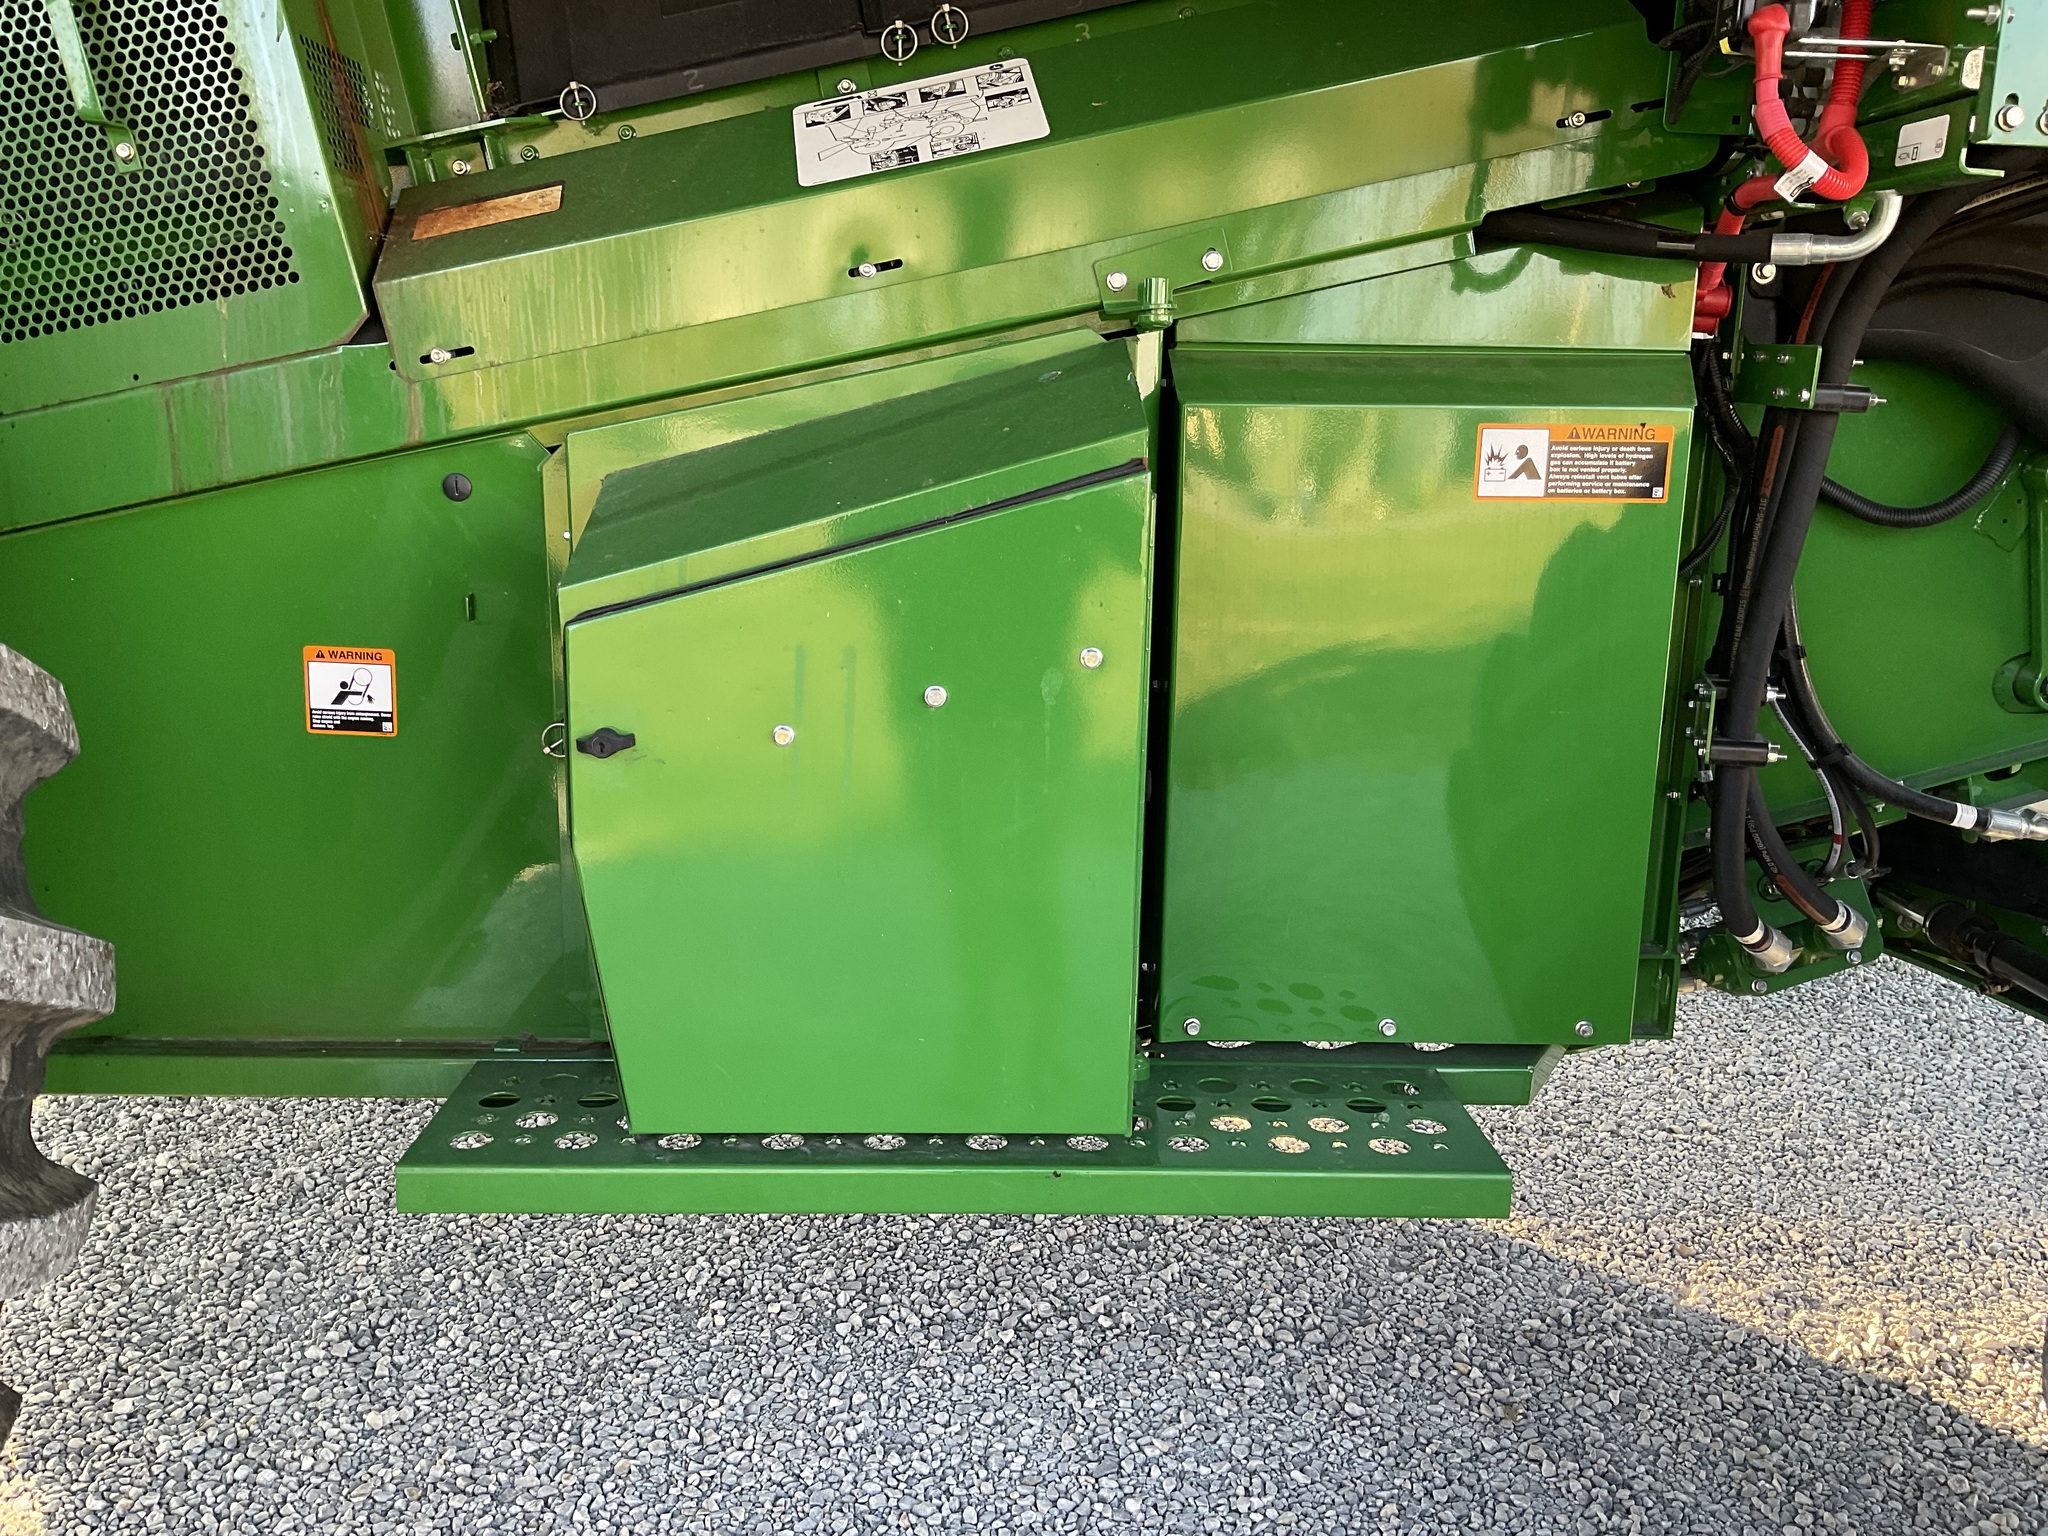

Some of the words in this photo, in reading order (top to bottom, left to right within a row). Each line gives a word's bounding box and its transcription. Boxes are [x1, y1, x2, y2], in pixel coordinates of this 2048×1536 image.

[682, 69, 704, 90] 2
[1582, 427, 1656, 440] WARNING
[328, 650, 382, 661] WARNING
[1760, 849, 1772, 863] MPa
